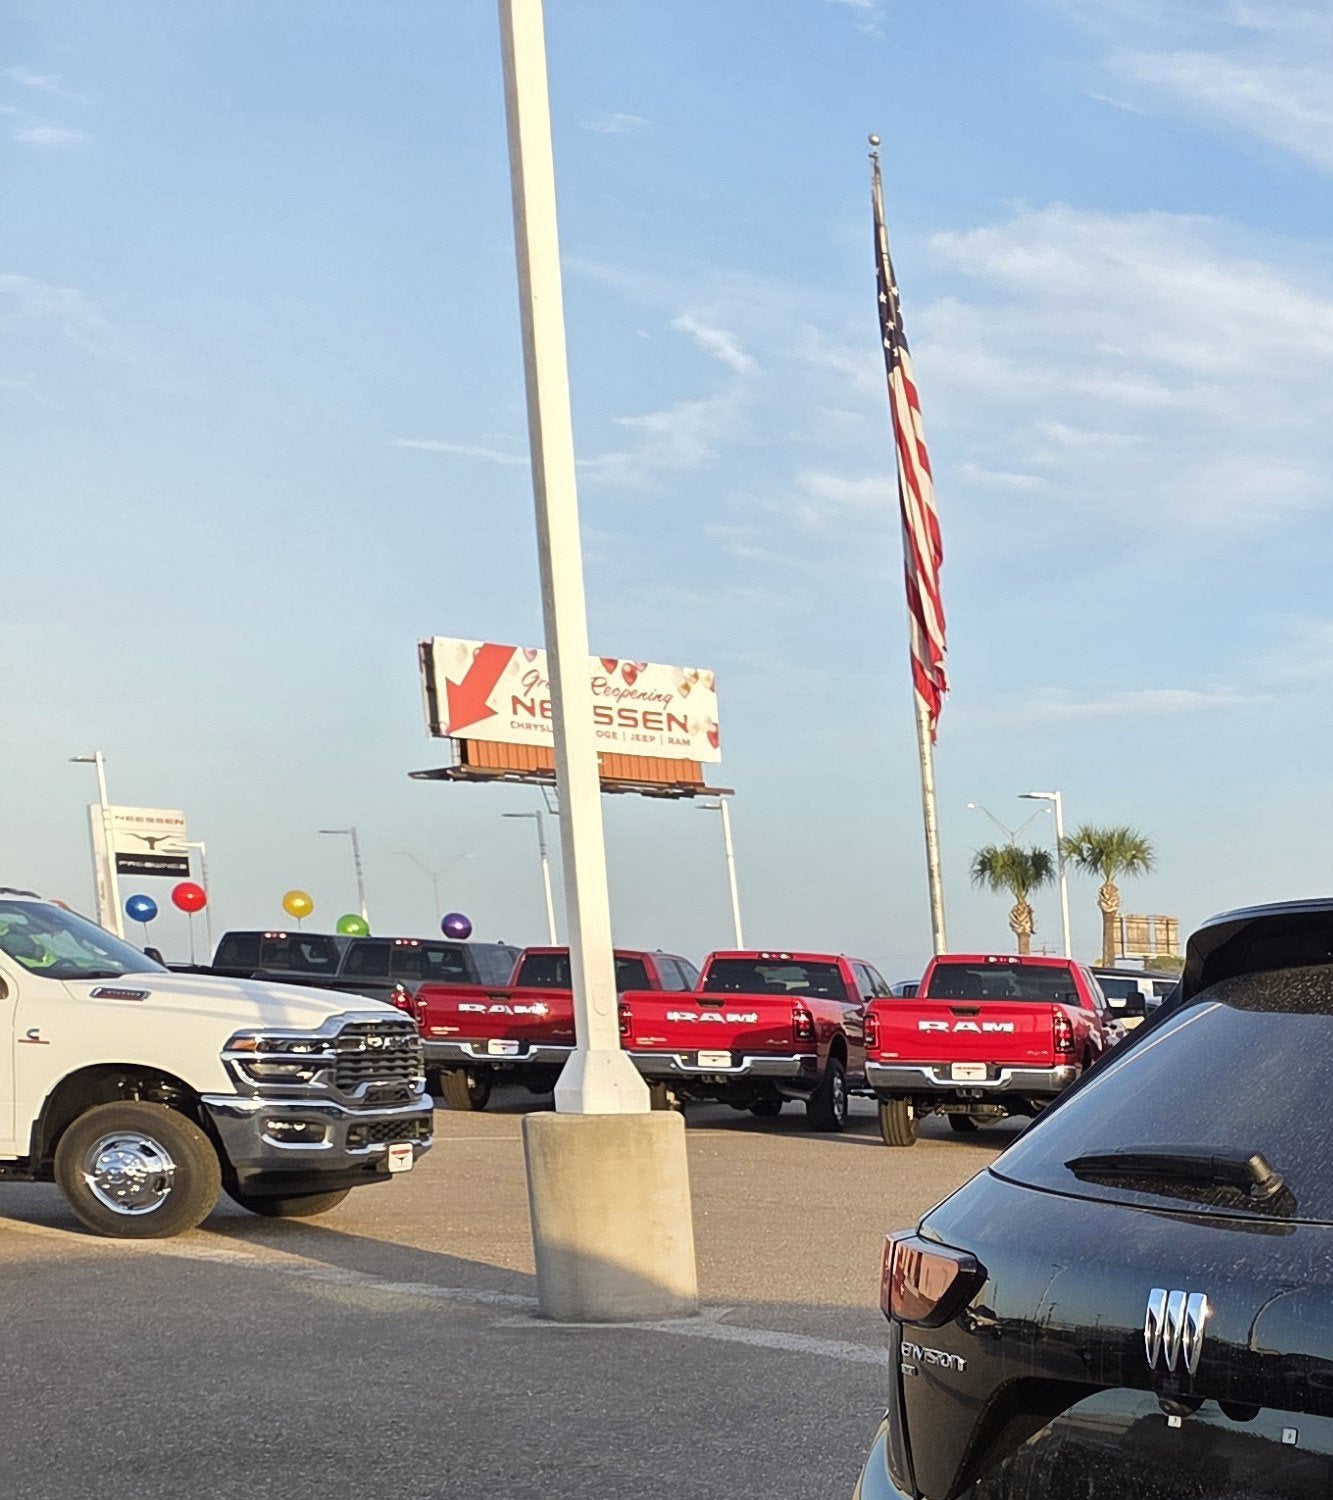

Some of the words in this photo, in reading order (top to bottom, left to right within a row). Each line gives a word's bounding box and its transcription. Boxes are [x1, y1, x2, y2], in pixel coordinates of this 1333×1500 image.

[590, 675, 674, 711] Reopening
[511, 694, 689, 734] NESSEN
[667, 736, 691, 746] RAM
[457, 1002, 549, 1016] RAM
[666, 1011, 759, 1024] RAM
[918, 1020, 1014, 1034] RAM
